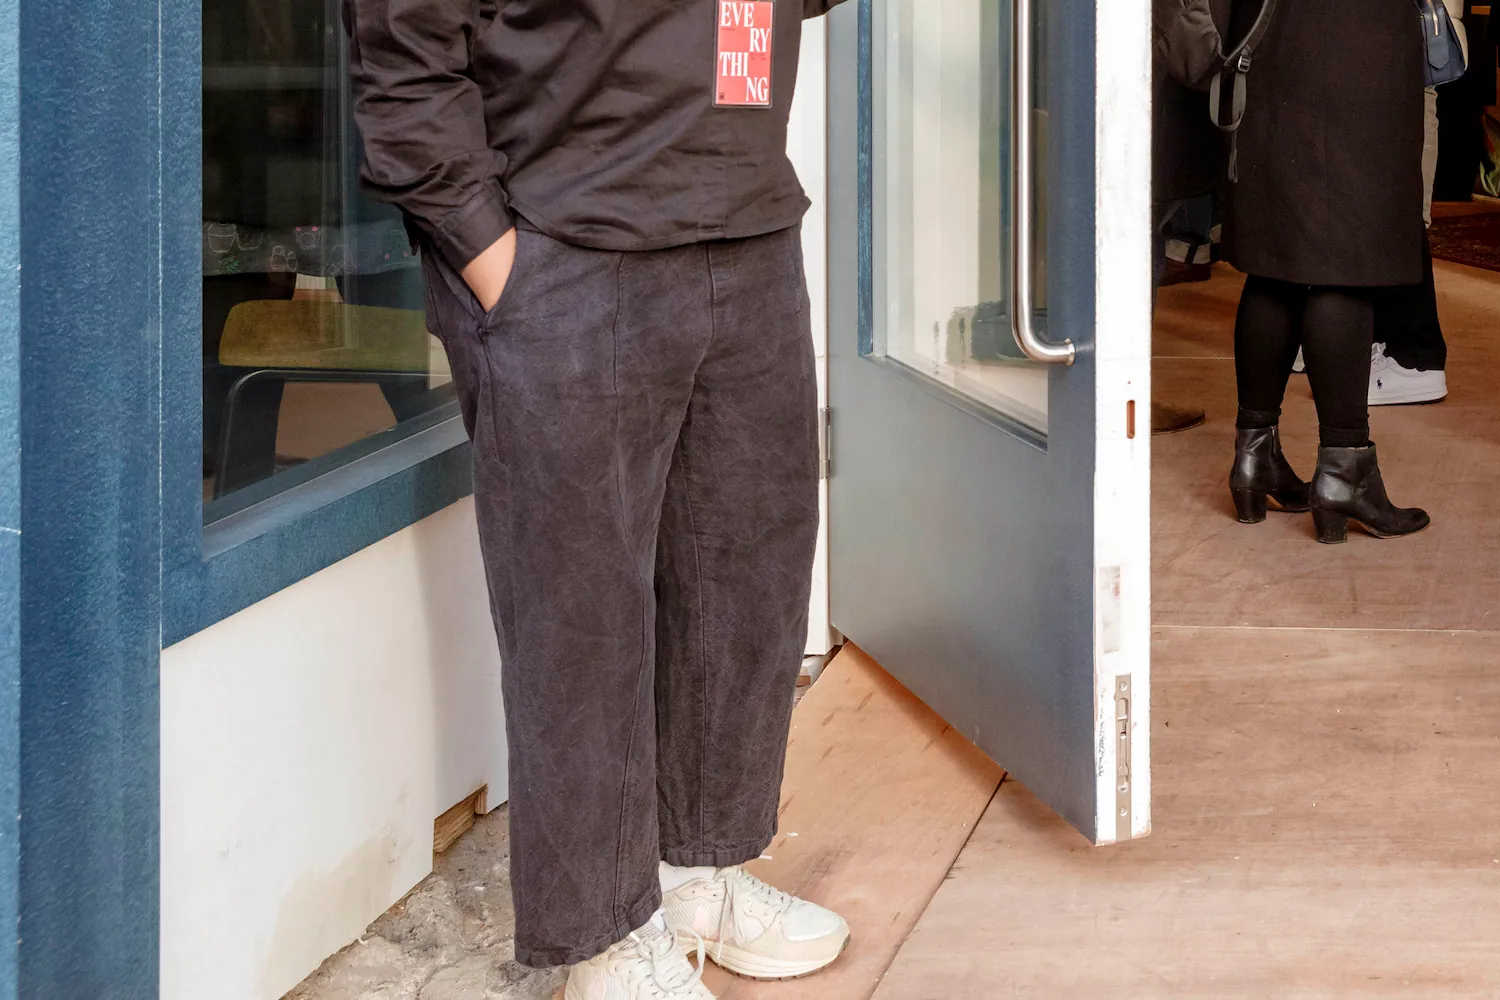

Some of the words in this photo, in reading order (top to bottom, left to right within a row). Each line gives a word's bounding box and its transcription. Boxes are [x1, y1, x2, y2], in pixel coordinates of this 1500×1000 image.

[720, 2, 754, 27] EVE
[749, 27, 770, 53] RY
[719, 52, 749, 77] THI
[745, 77, 769, 102] NG
